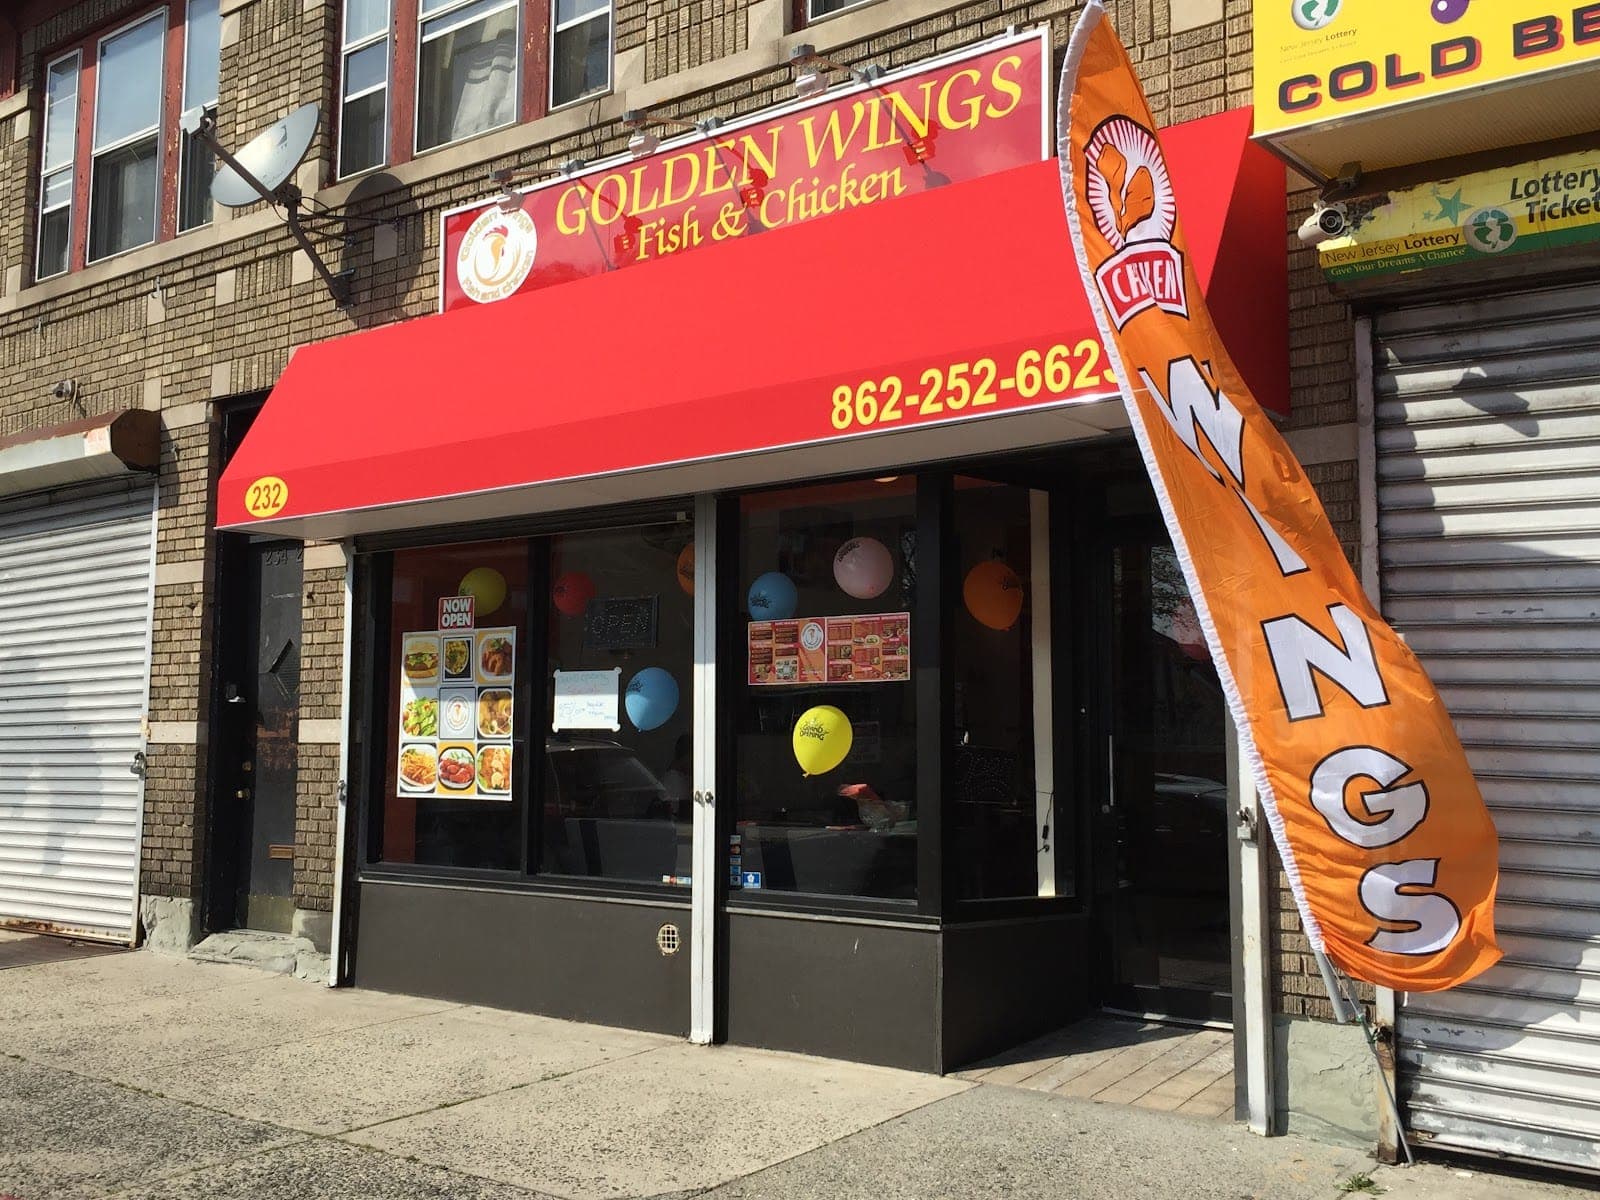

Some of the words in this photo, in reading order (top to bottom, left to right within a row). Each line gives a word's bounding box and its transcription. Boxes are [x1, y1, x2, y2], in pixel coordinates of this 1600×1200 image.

[1325, 28, 1358, 41] Lottery
[1278, 36, 1481, 114] COLD
[555, 126, 783, 236] GOLDEN
[798, 55, 1025, 168] WINGS
[1510, 168, 1600, 200] Lottery
[635, 221, 703, 262] Fish
[711, 201, 748, 242] &
[760, 163, 907, 231] Chicken
[1325, 251, 1356, 264] New
[1361, 242, 1400, 259] Jersey
[1404, 233, 1460, 250] Lottery
[1331, 266, 1353, 276] Give
[1354, 262, 1375, 273] Your
[1377, 256, 1416, 269] Dreams
[252, 483, 281, 511] 232
[441, 612, 472, 627] OPEN
[443, 598, 472, 613] NOW
